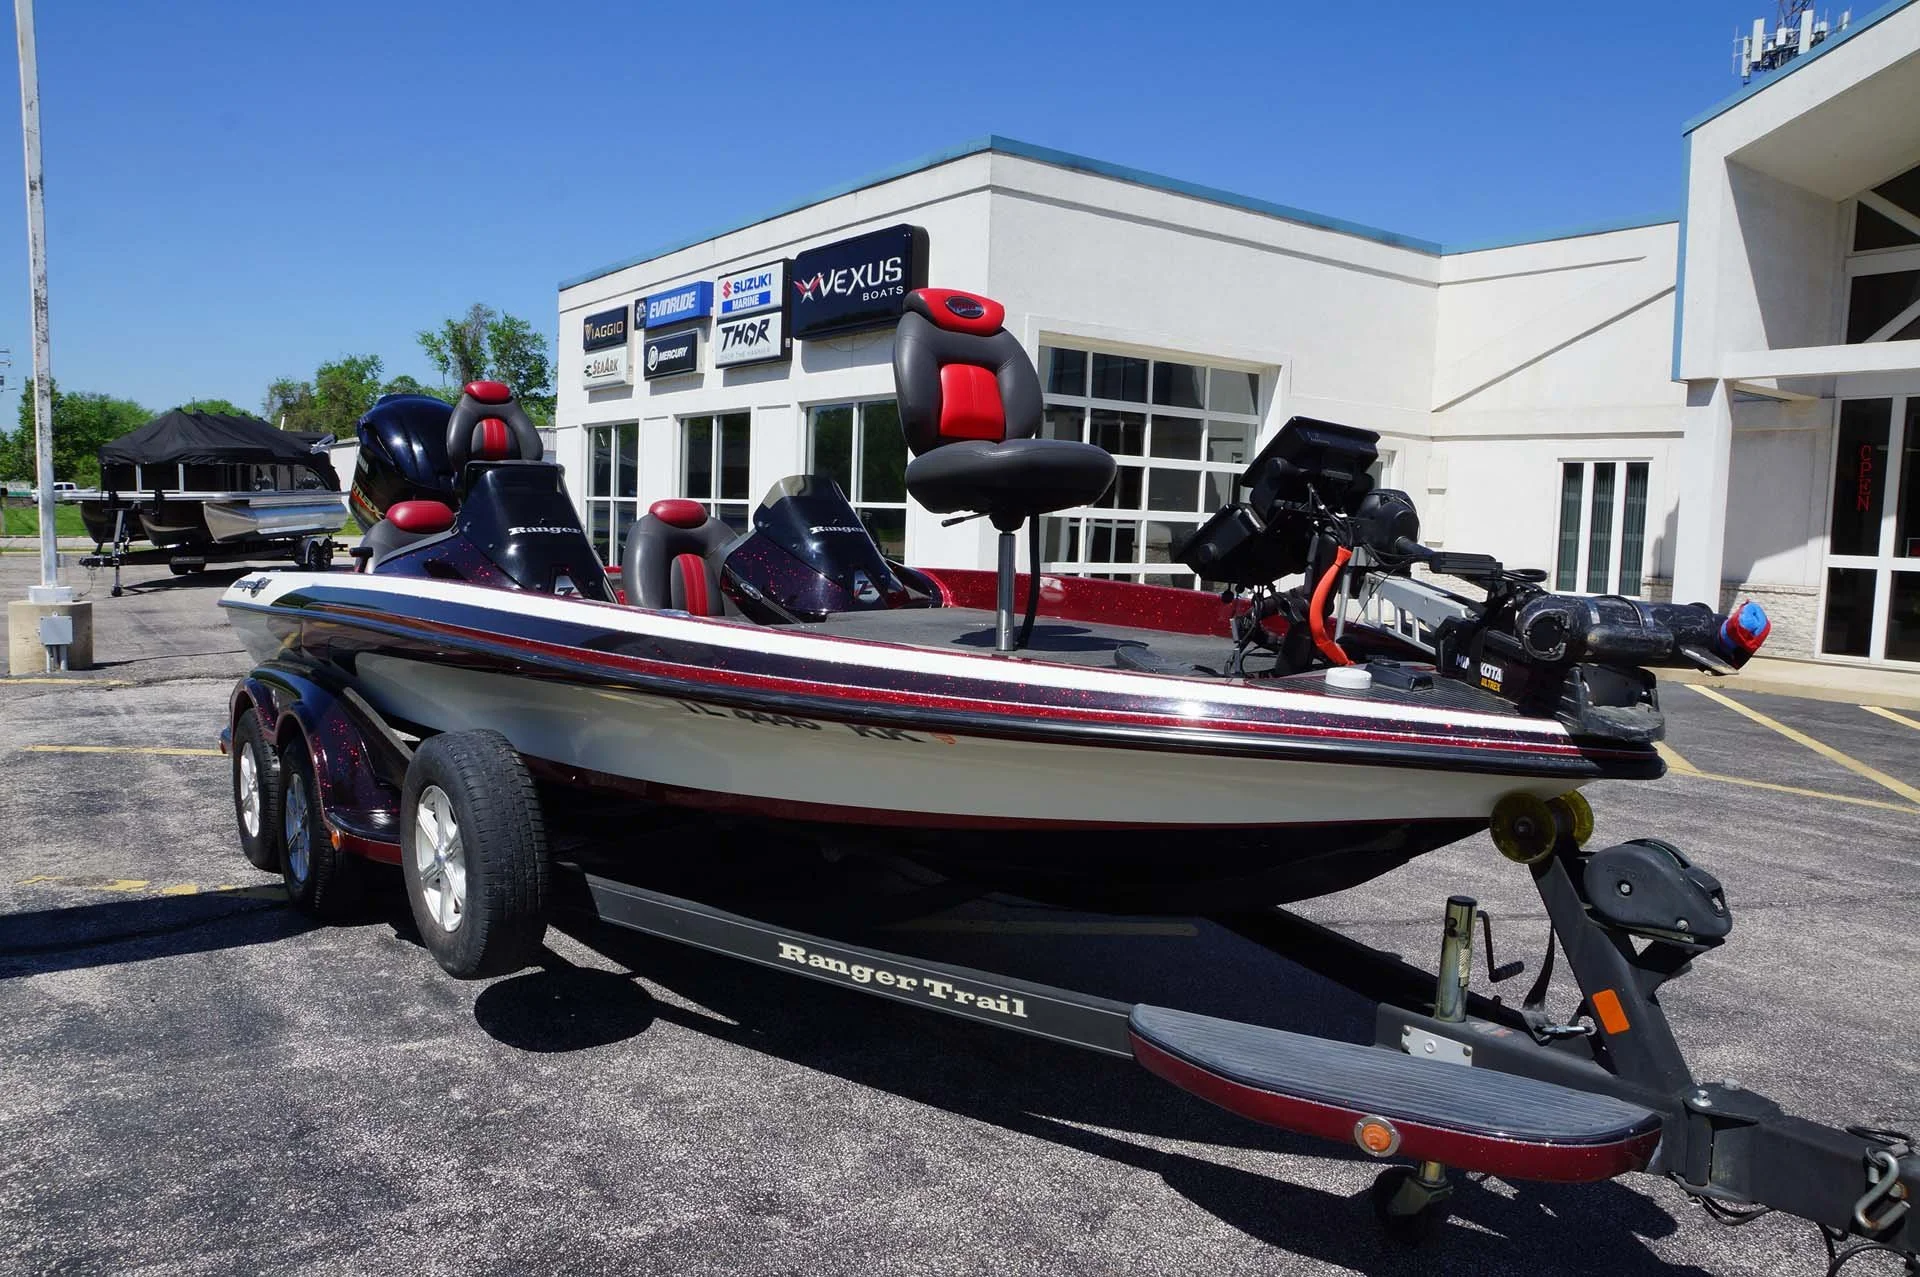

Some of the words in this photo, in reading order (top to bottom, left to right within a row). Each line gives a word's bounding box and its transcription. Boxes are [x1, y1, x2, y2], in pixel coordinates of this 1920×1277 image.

[733, 273, 772, 294] SUZUKI
[819, 257, 903, 297] VEXUS
[732, 294, 759, 309] MARINE
[862, 286, 904, 301] BOATS
[649, 291, 697, 319] EVINRUDE
[584, 321, 624, 342] VIAGGIO
[721, 318, 770, 352] THOR
[658, 346, 689, 362] MERCURY
[1857, 445, 1872, 512] OPEN
[508, 526, 581, 536] Ranger
[810, 526, 866, 535] Range
[778, 941, 918, 991] Ranger
[923, 978, 1028, 1018] Trail
